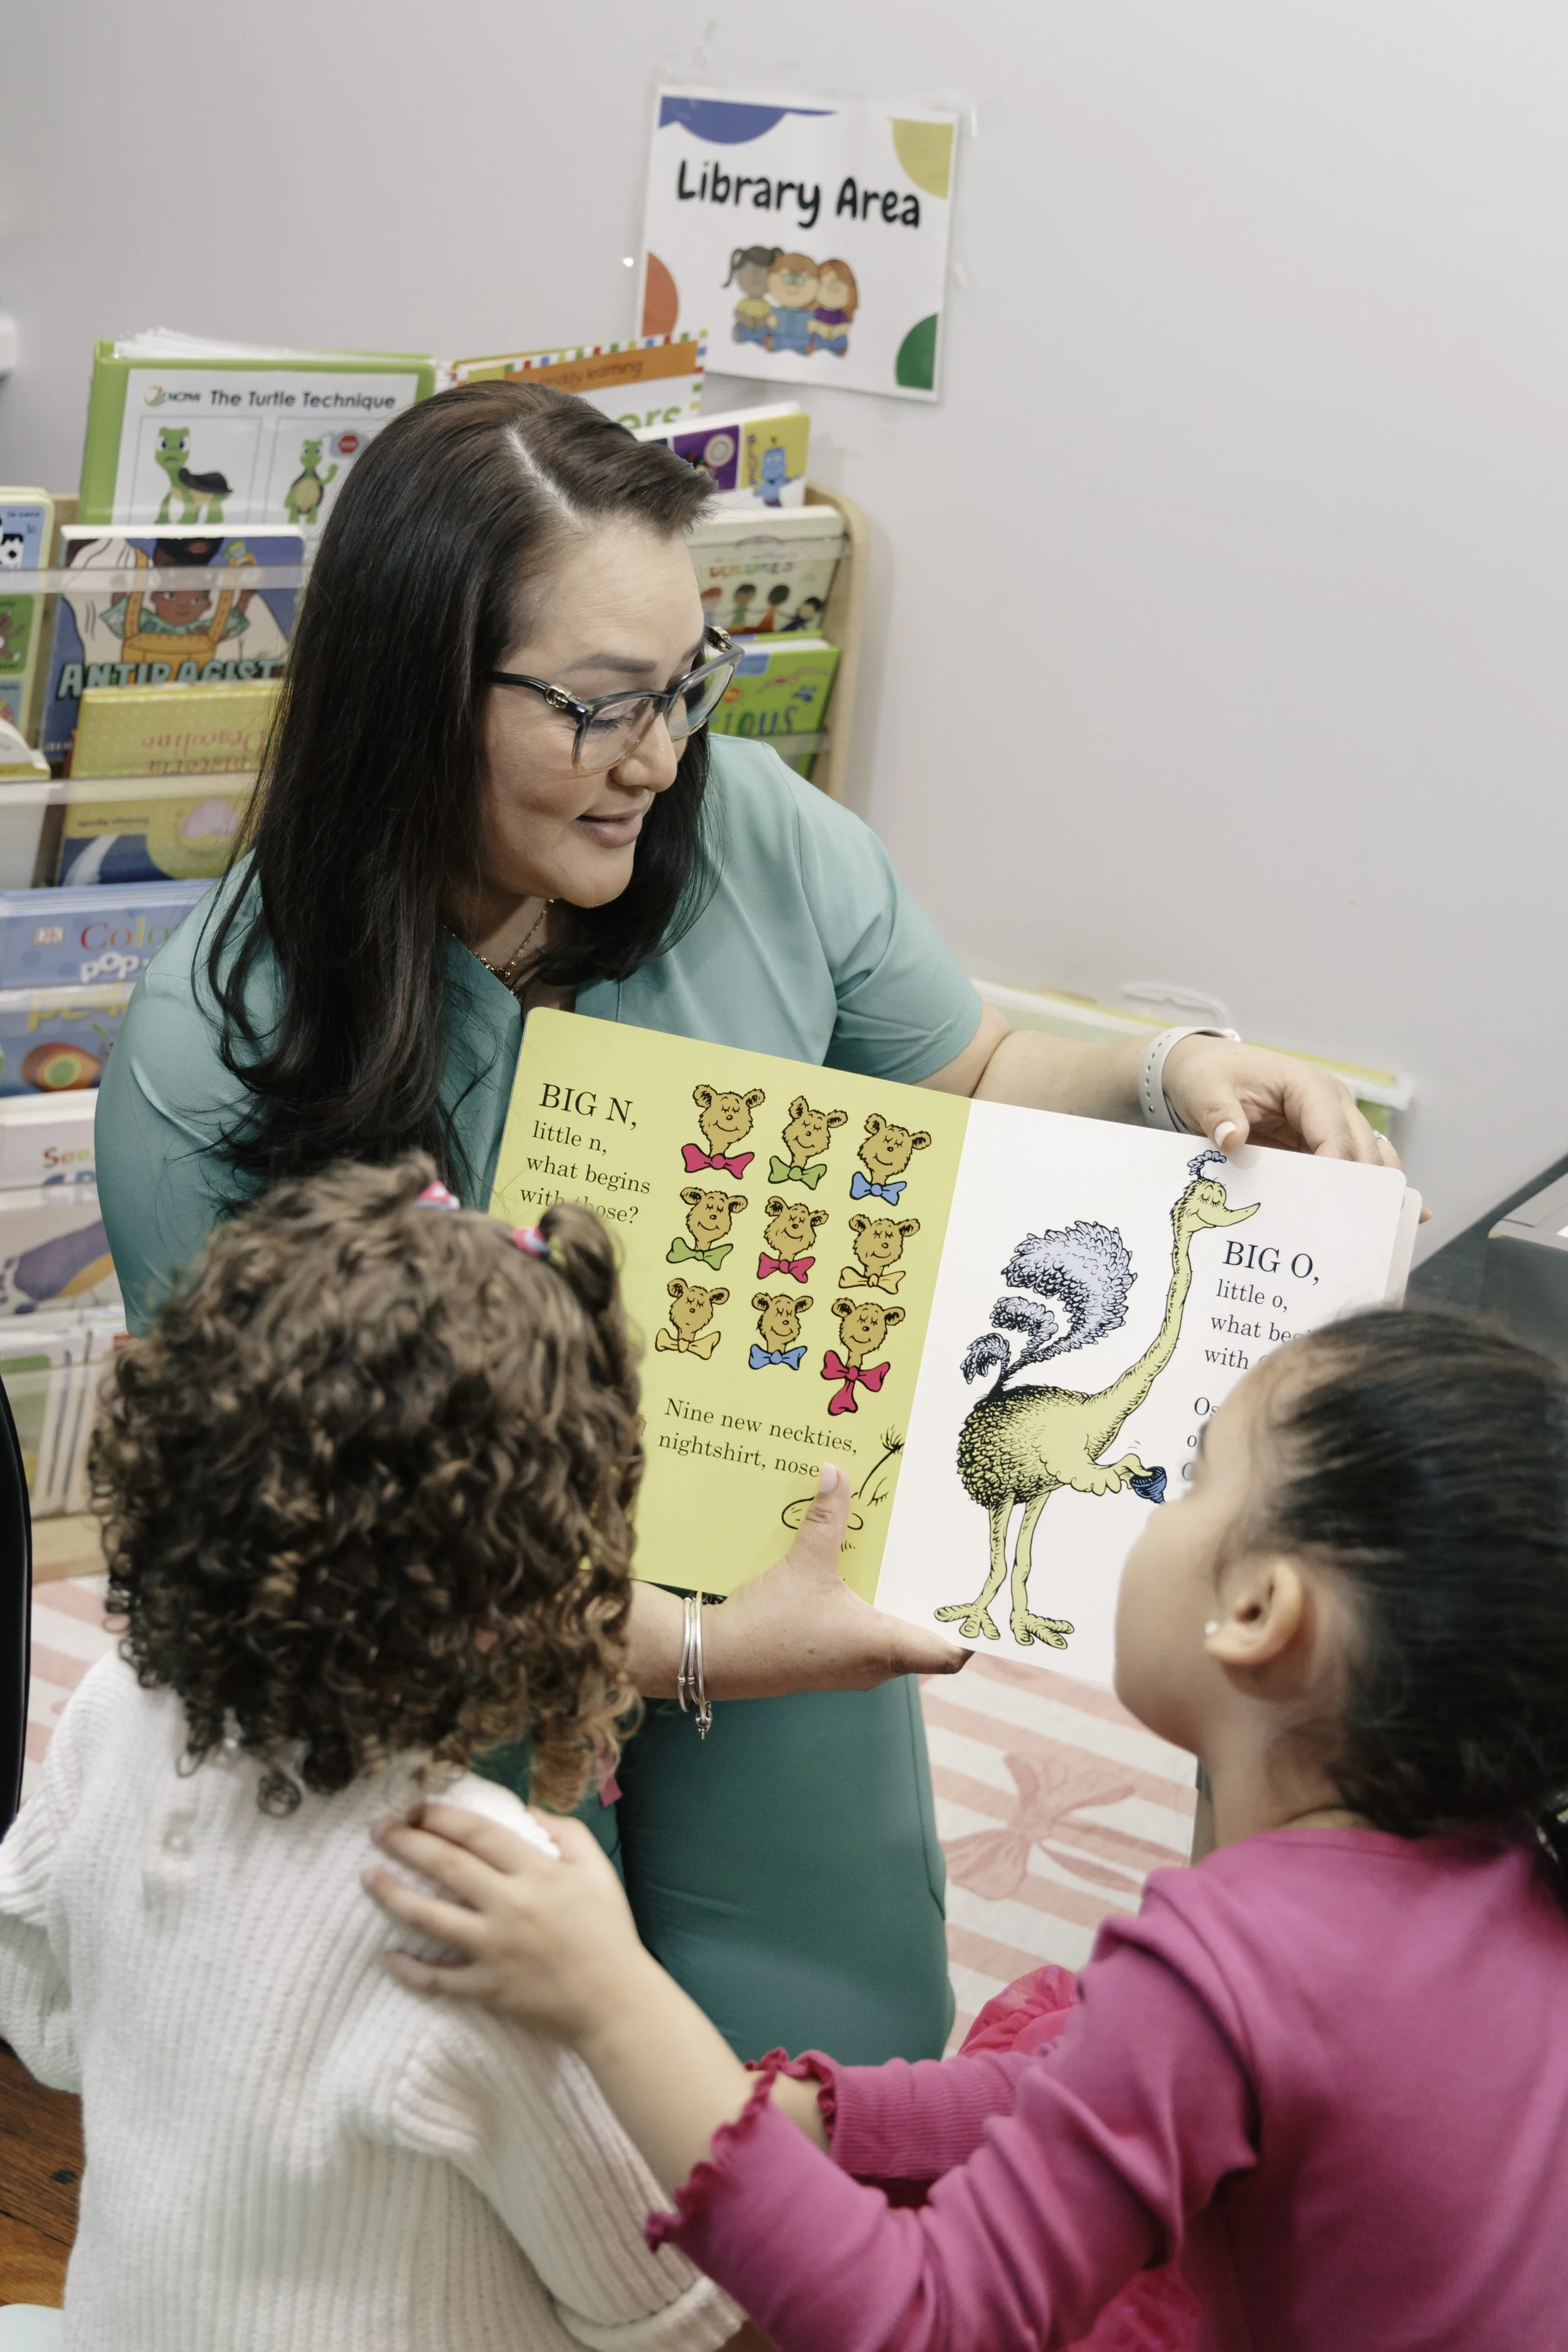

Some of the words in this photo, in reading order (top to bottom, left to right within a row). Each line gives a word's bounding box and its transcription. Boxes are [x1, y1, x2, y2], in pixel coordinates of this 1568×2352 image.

[676, 159, 820, 230] Library
[835, 176, 921, 230] Area
[210, 390, 241, 406] The
[249, 391, 295, 408] Turtle
[302, 392, 396, 411] Technique
[539, 1083, 598, 1116] BIG
[605, 1097, 637, 1130] N,
[532, 1120, 582, 1147] little
[588, 1136, 607, 1155] n,
[526, 1155, 578, 1180] what
[585, 1163, 651, 1194] begins
[1222, 1240, 1281, 1274] BIG
[1291, 1253, 1320, 1286] O,
[1216, 1278, 1265, 1305] little
[1272, 1295, 1288, 1313] o,
[1210, 1314, 1261, 1338] what
[1204, 1347, 1249, 1370] with
[664, 1397, 714, 1424] Nine
[721, 1415, 763, 1433] new
[768, 1425, 857, 1456] neckties,
[657, 1433, 766, 1470] nightshirt,
[774, 1458, 820, 1478] nose
